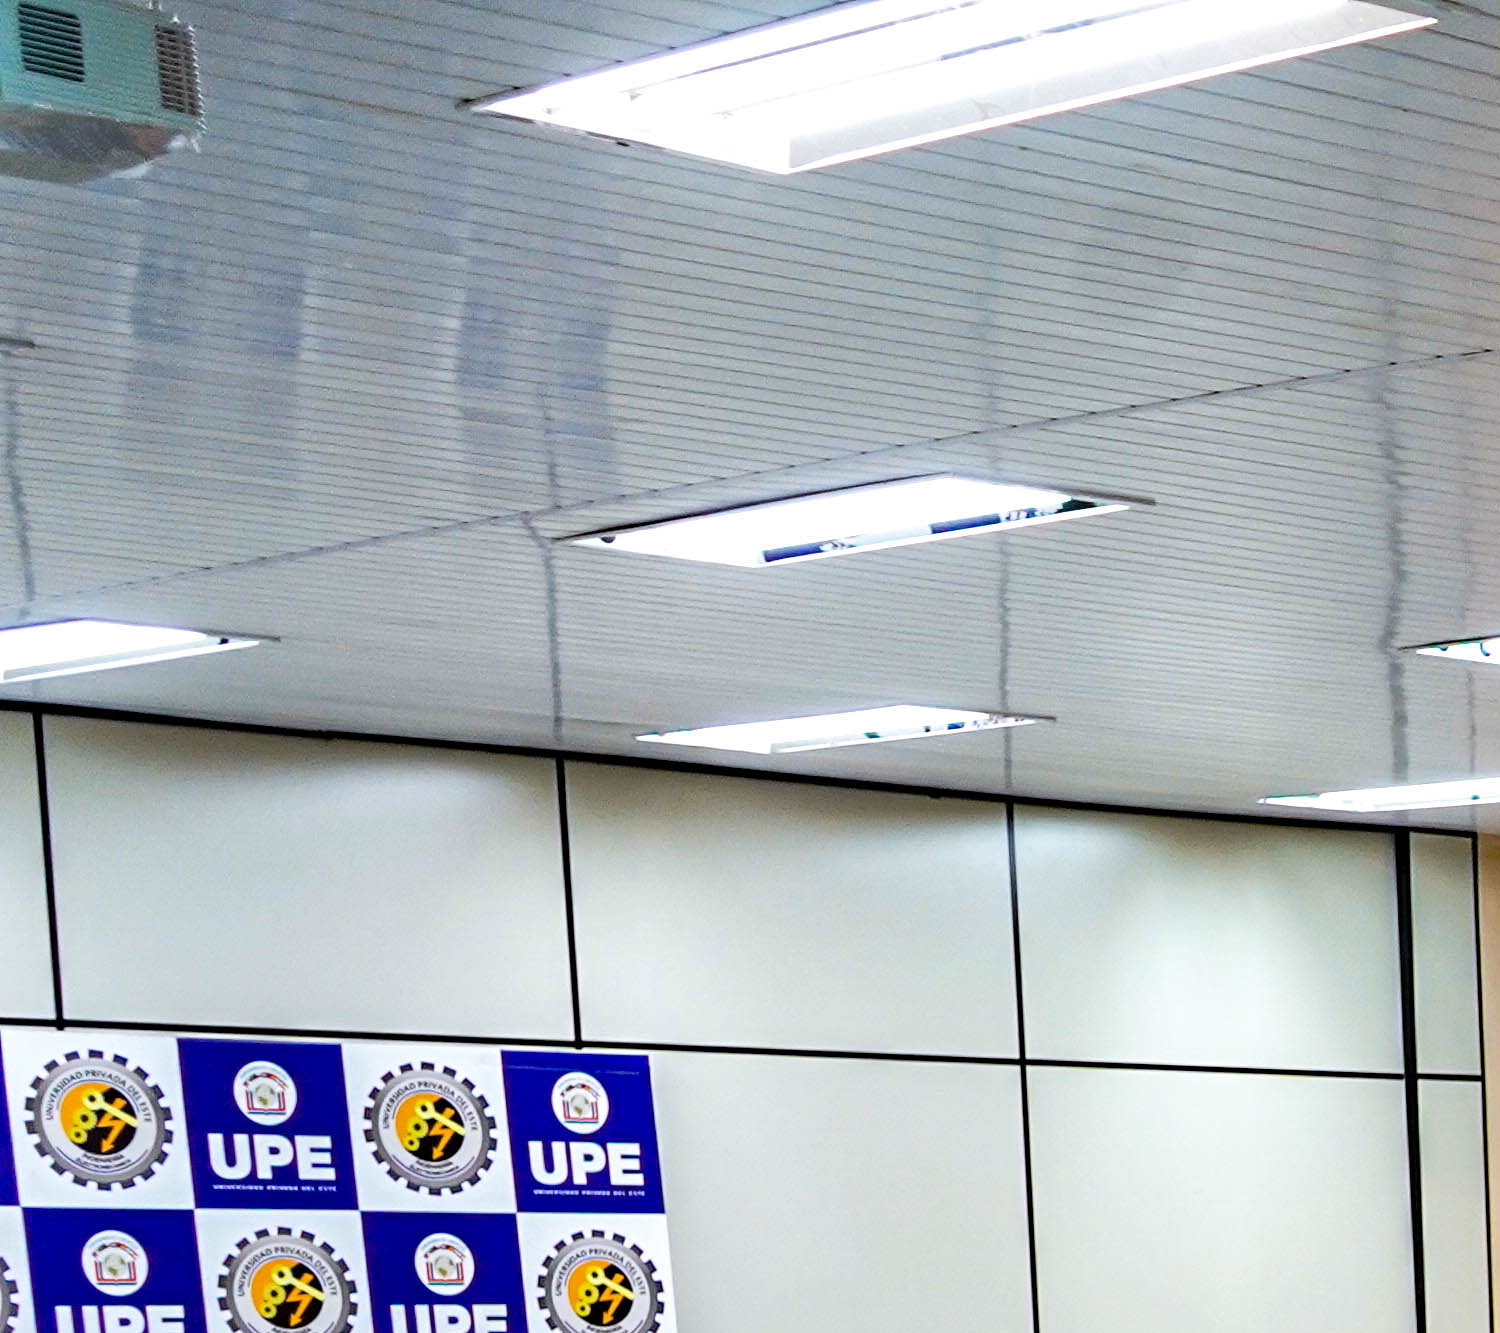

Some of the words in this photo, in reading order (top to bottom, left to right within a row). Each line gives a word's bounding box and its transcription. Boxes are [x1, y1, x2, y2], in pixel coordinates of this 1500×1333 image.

[85, 1069, 127, 1087] PRIVADA
[127, 1085, 142, 1103] DEL
[139, 1101, 152, 1122] ESTE
[417, 1080, 456, 1097] PRIVADA
[456, 1094, 470, 1112] DEL
[207, 1132, 337, 1181] UPE
[527, 1140, 645, 1186] UPE
[274, 1246, 314, 1263] PRIVADA
[314, 1260, 329, 1276] DEL
[588, 1248, 624, 1264] PRIVADA
[625, 1260, 639, 1277] DEL
[635, 1275, 647, 1295] ESTE
